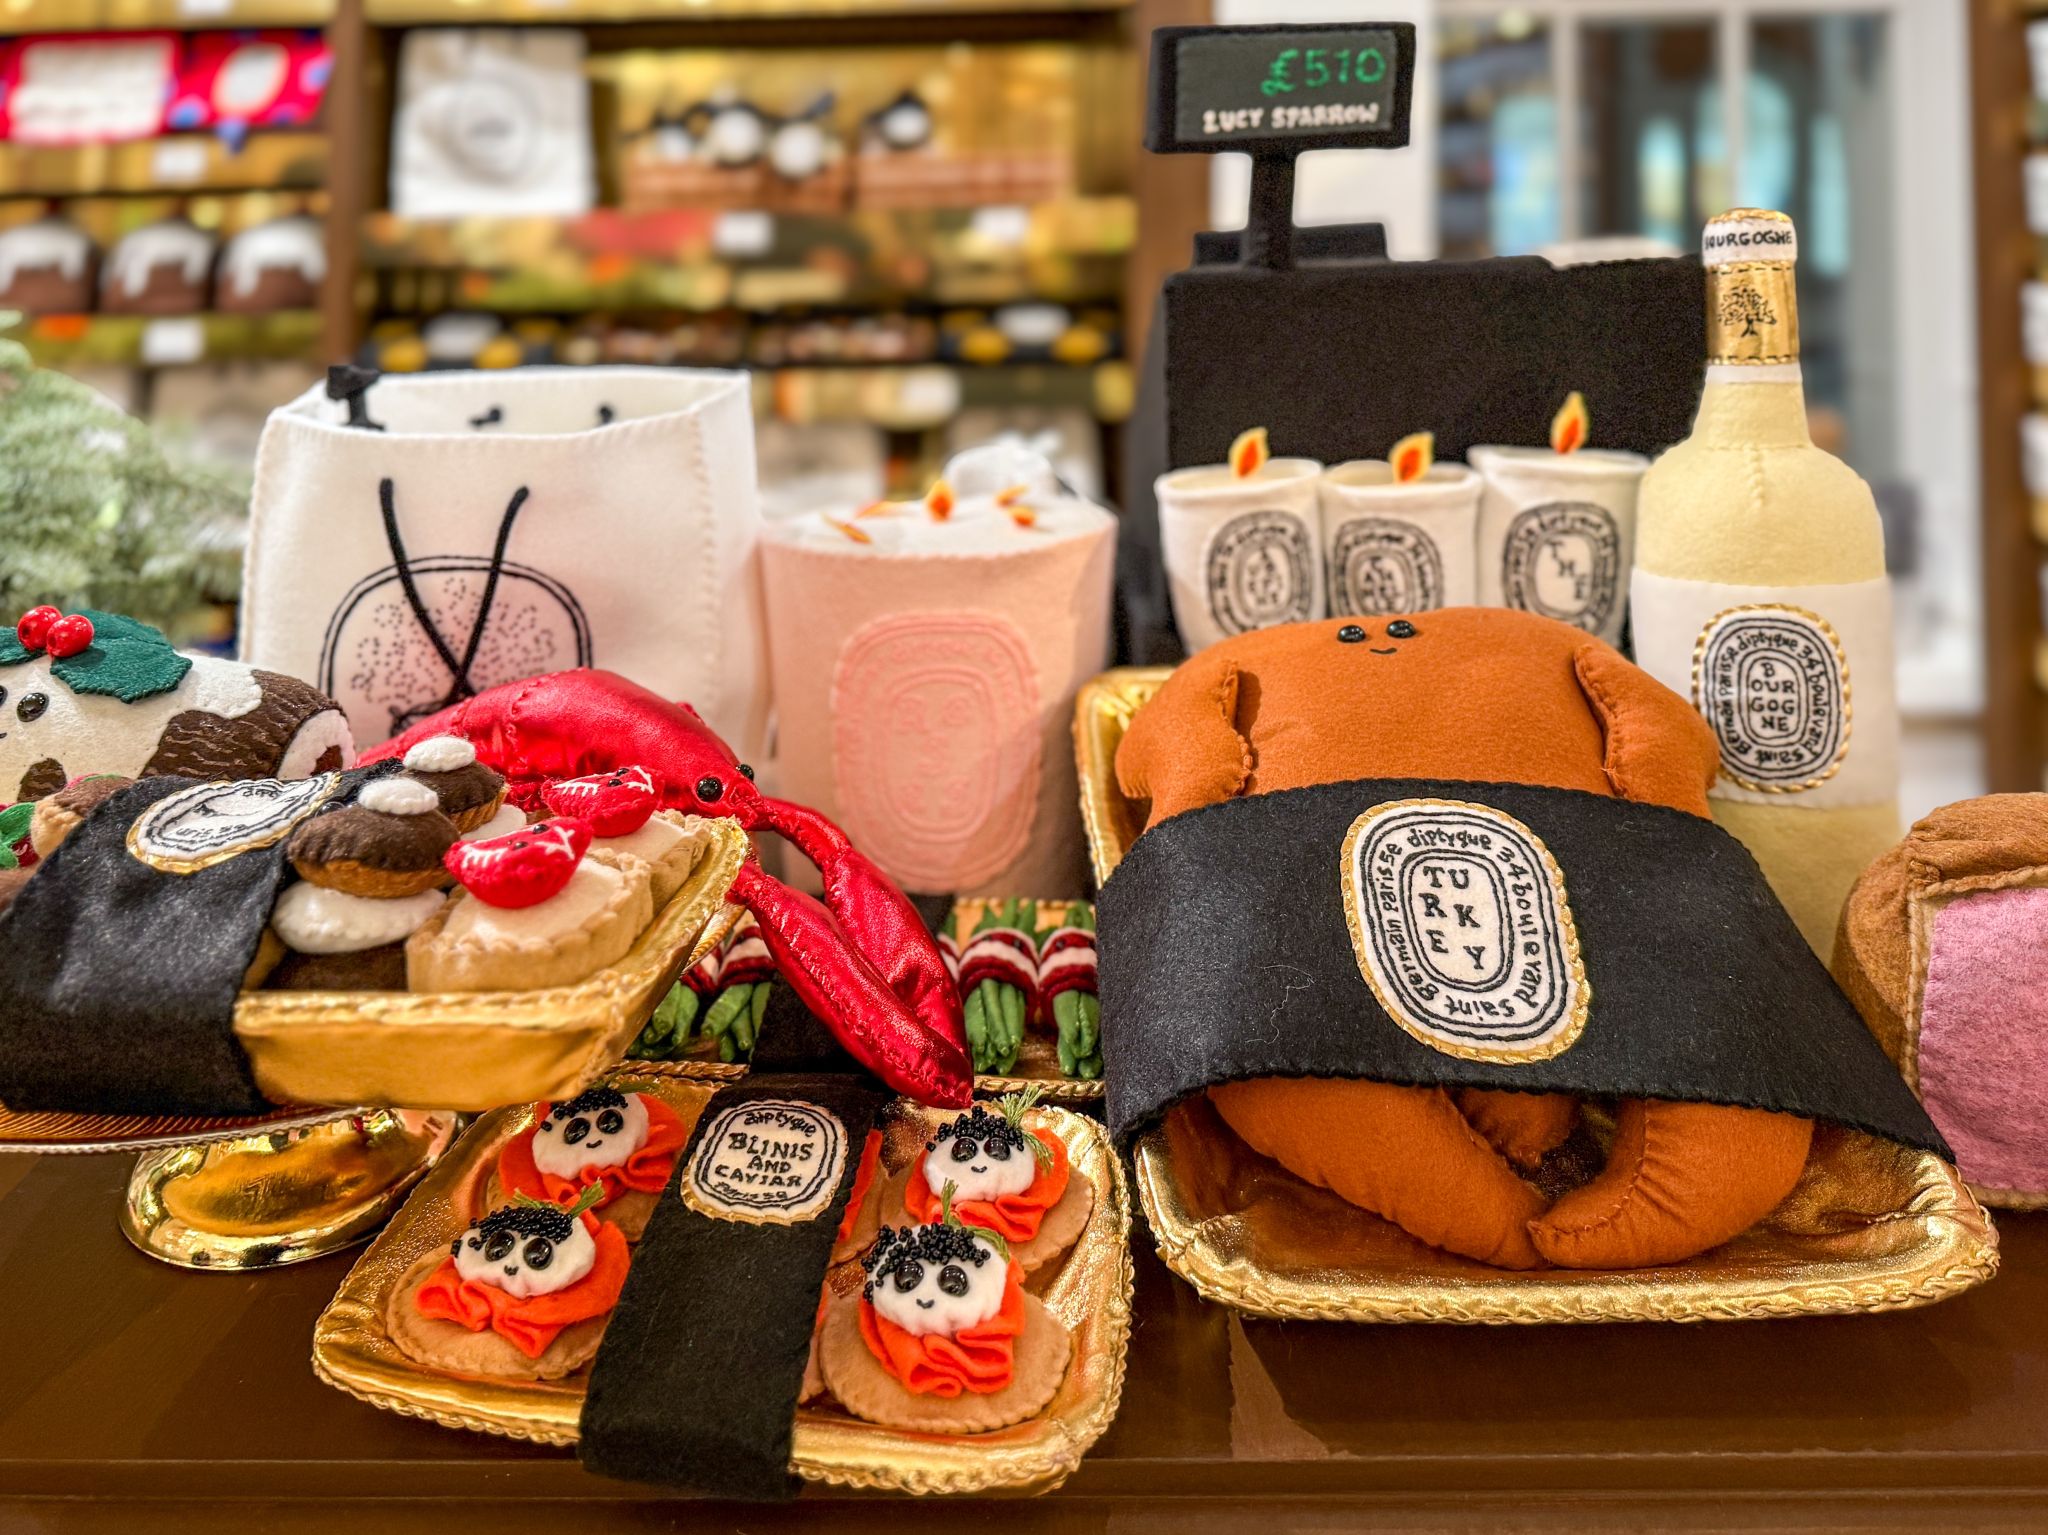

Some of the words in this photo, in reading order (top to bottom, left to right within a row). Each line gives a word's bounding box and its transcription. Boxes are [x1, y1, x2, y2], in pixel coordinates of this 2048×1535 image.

[1260, 48, 1386, 96] £510
[1202, 107, 1264, 134] LUCY
[1271, 102, 1379, 129] SPARROW
[1407, 827, 1492, 850] diptyque
[728, 1132, 815, 1161] BLINIS
[714, 1164, 802, 1187] CAVIAR
[747, 1155, 792, 1173] AND
